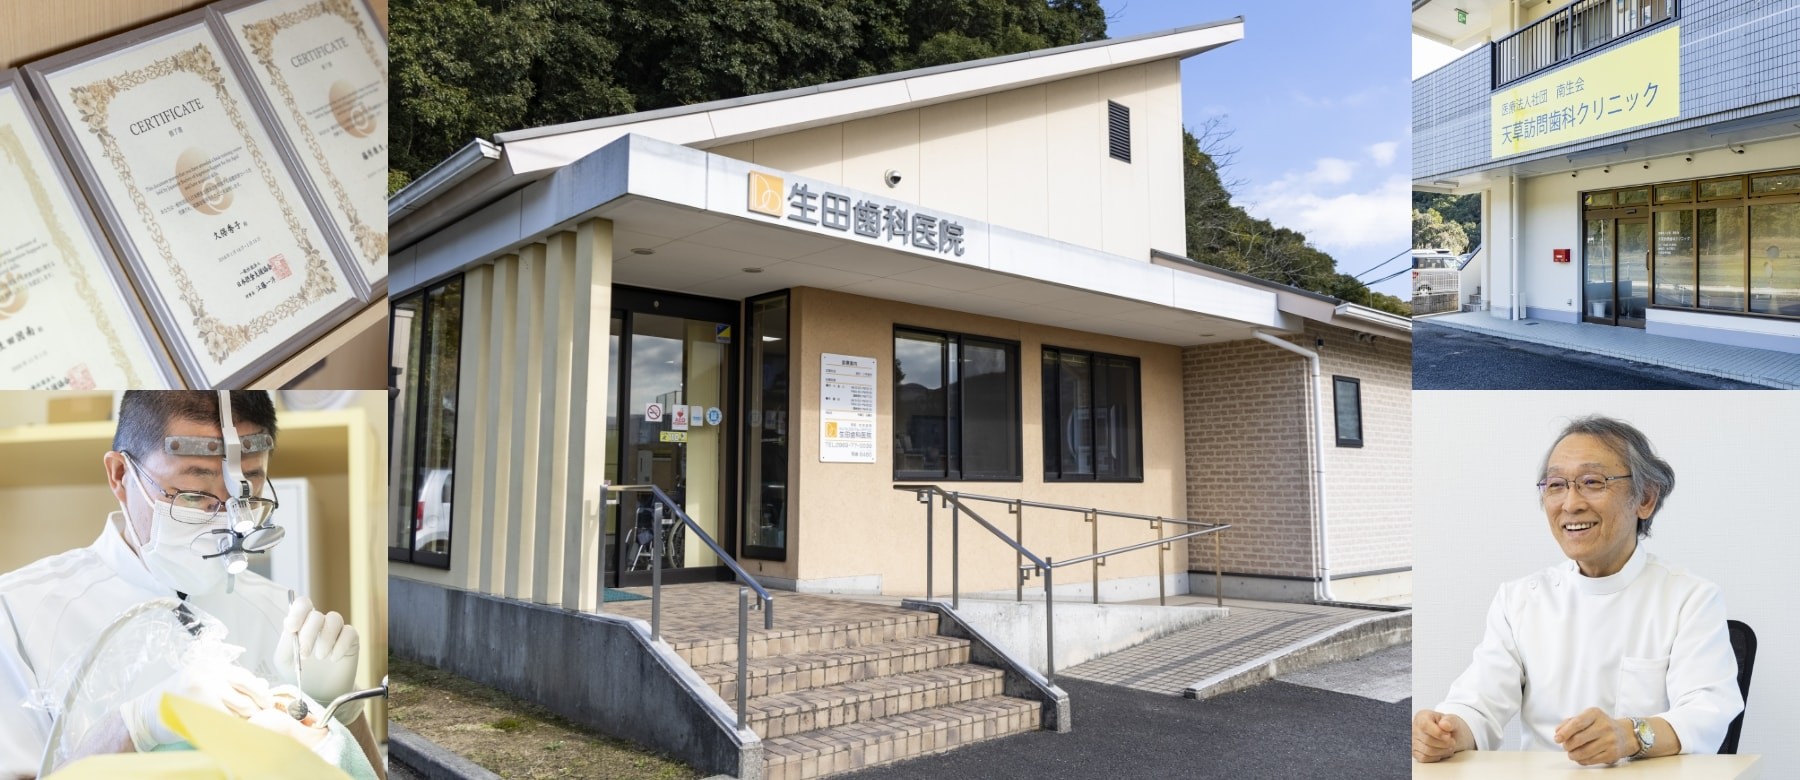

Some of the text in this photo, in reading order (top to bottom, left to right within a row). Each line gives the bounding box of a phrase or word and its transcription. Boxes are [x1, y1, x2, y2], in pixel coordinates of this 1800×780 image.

[290, 37, 349, 68] CERTIFICATE
[129, 98, 204, 136] CERTIFICATE
[1501, 76, 1585, 117] 医療法人社団 南生会
[1501, 82, 1659, 145] 天草訪問歯科クリニック
[787, 182, 965, 256] 生田歯科医院
